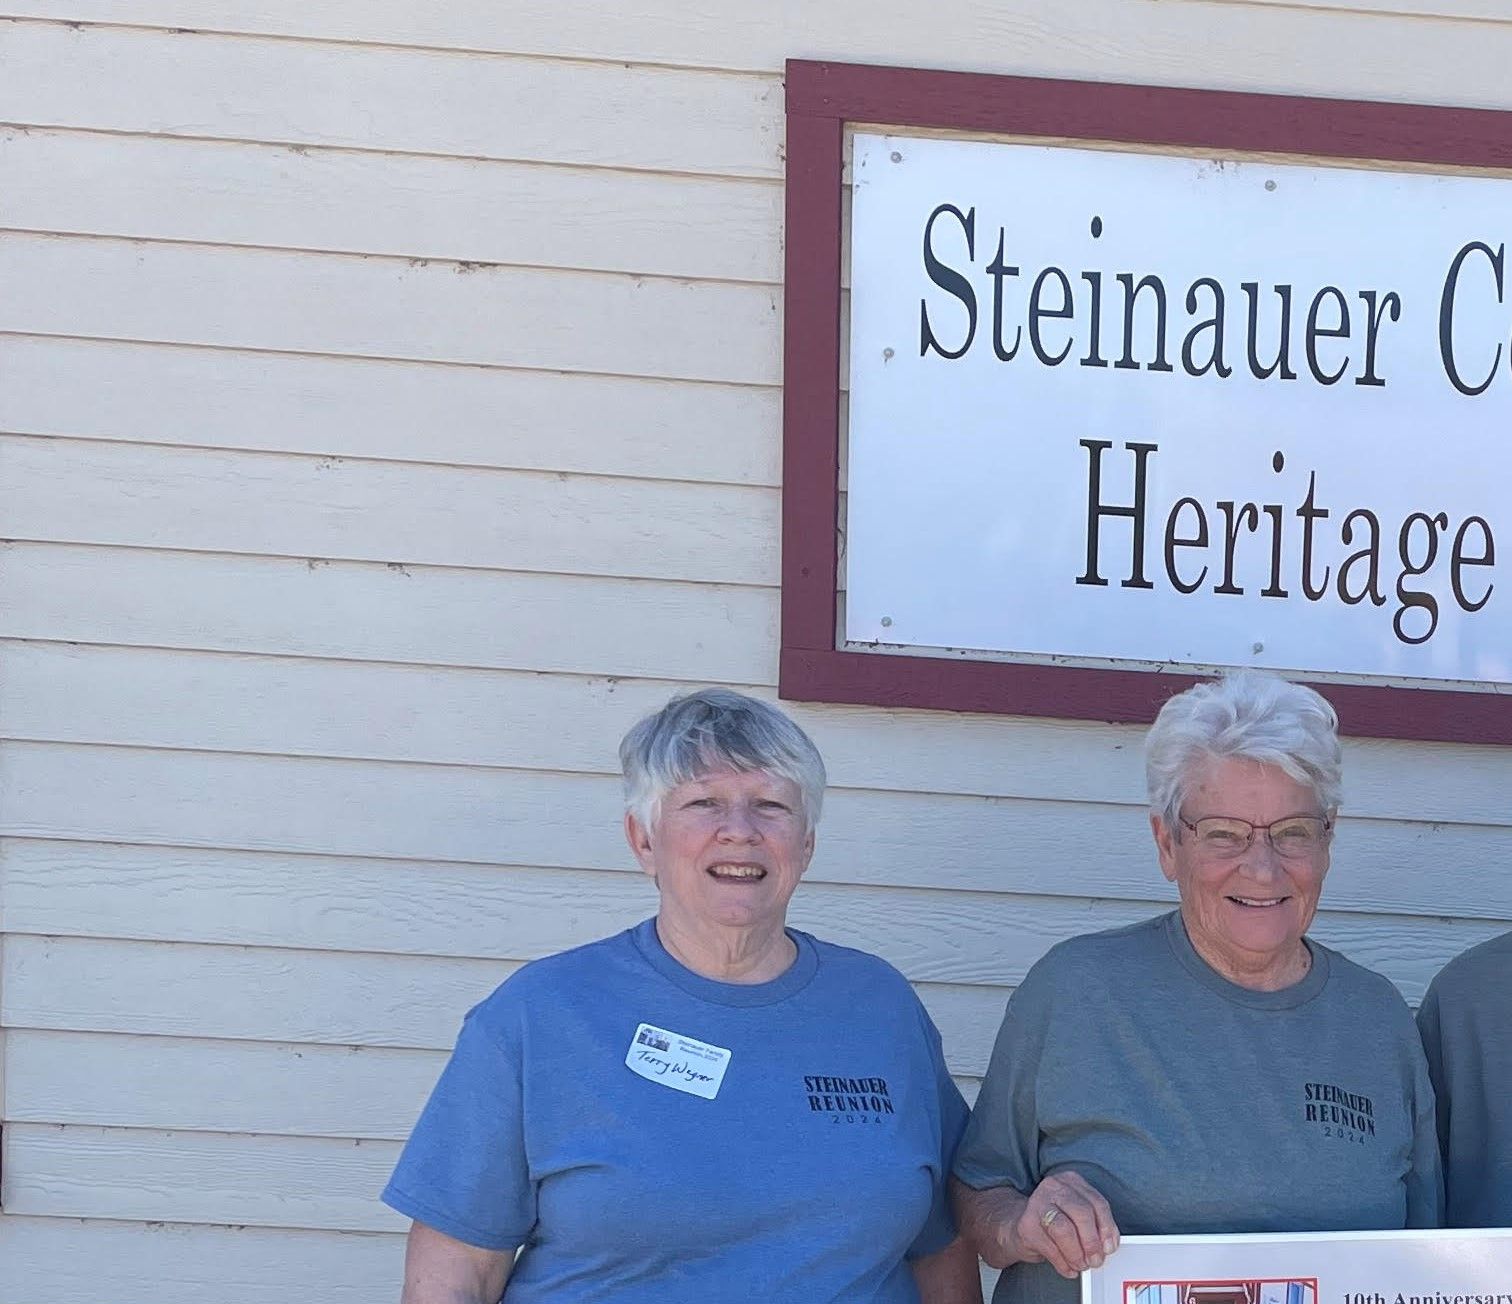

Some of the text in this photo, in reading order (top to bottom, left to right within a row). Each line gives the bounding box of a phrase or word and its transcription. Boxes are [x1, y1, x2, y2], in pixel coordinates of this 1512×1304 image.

[919, 202, 1401, 388] Steinauer
[1075, 439, 1496, 645] Heritage
[637, 1051, 670, 1075] Terry
[804, 1076, 889, 1096] STEINAUER
[1304, 1083, 1373, 1117] STEINAUER
[808, 1095, 894, 1114] REUNION
[832, 1115, 881, 1123] 2024
[1305, 1104, 1376, 1137] REUNION
